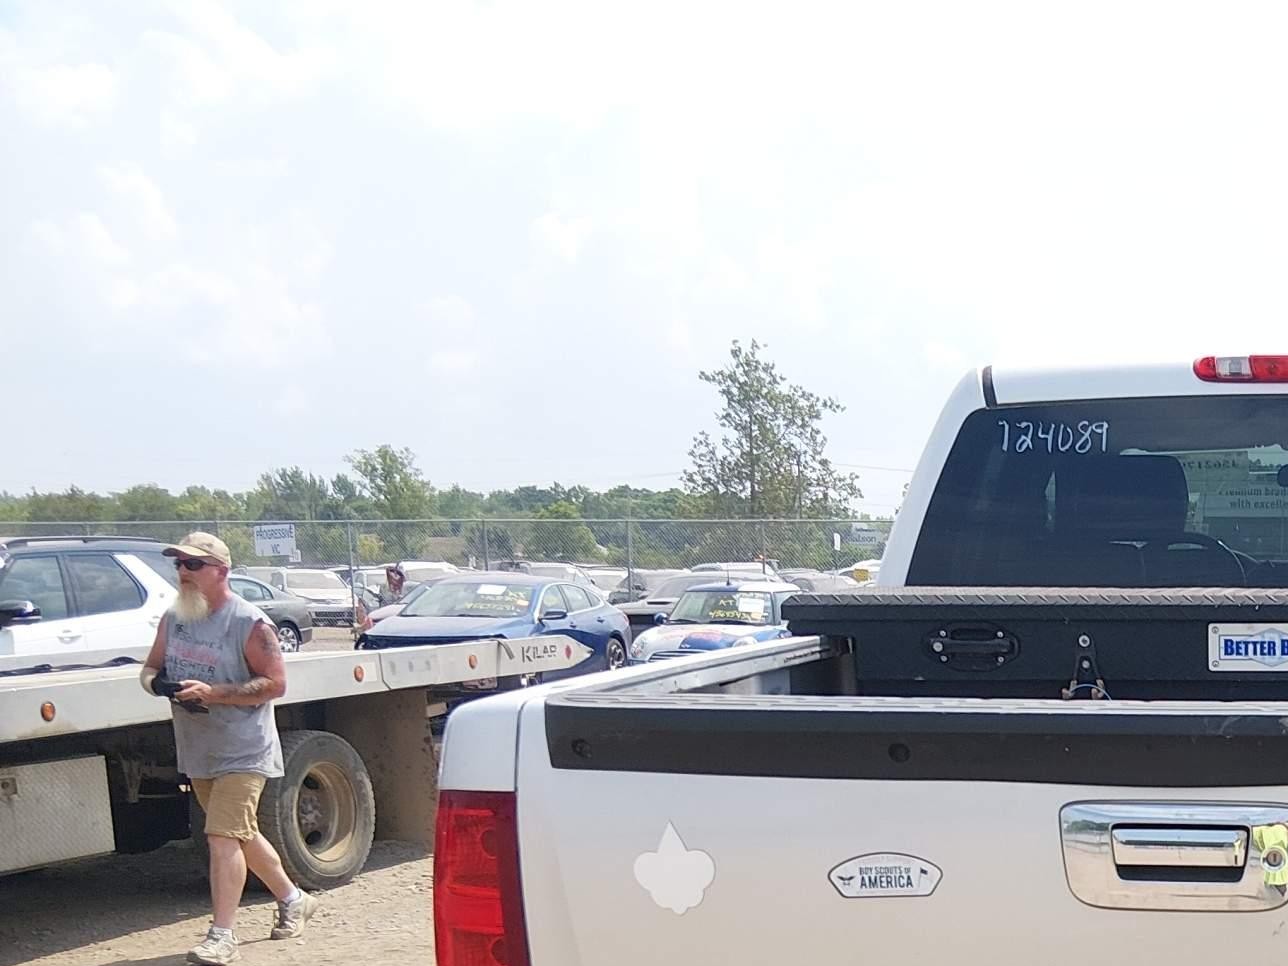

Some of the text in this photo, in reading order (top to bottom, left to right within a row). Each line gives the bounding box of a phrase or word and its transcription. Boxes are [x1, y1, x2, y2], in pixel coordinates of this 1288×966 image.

[1229, 498, 1250, 510] with
[1223, 638, 1277, 656] BETTER
[859, 867, 873, 875] BOY
[874, 866, 902, 875] SCOUTS
[860, 875, 914, 889] AMERICA
